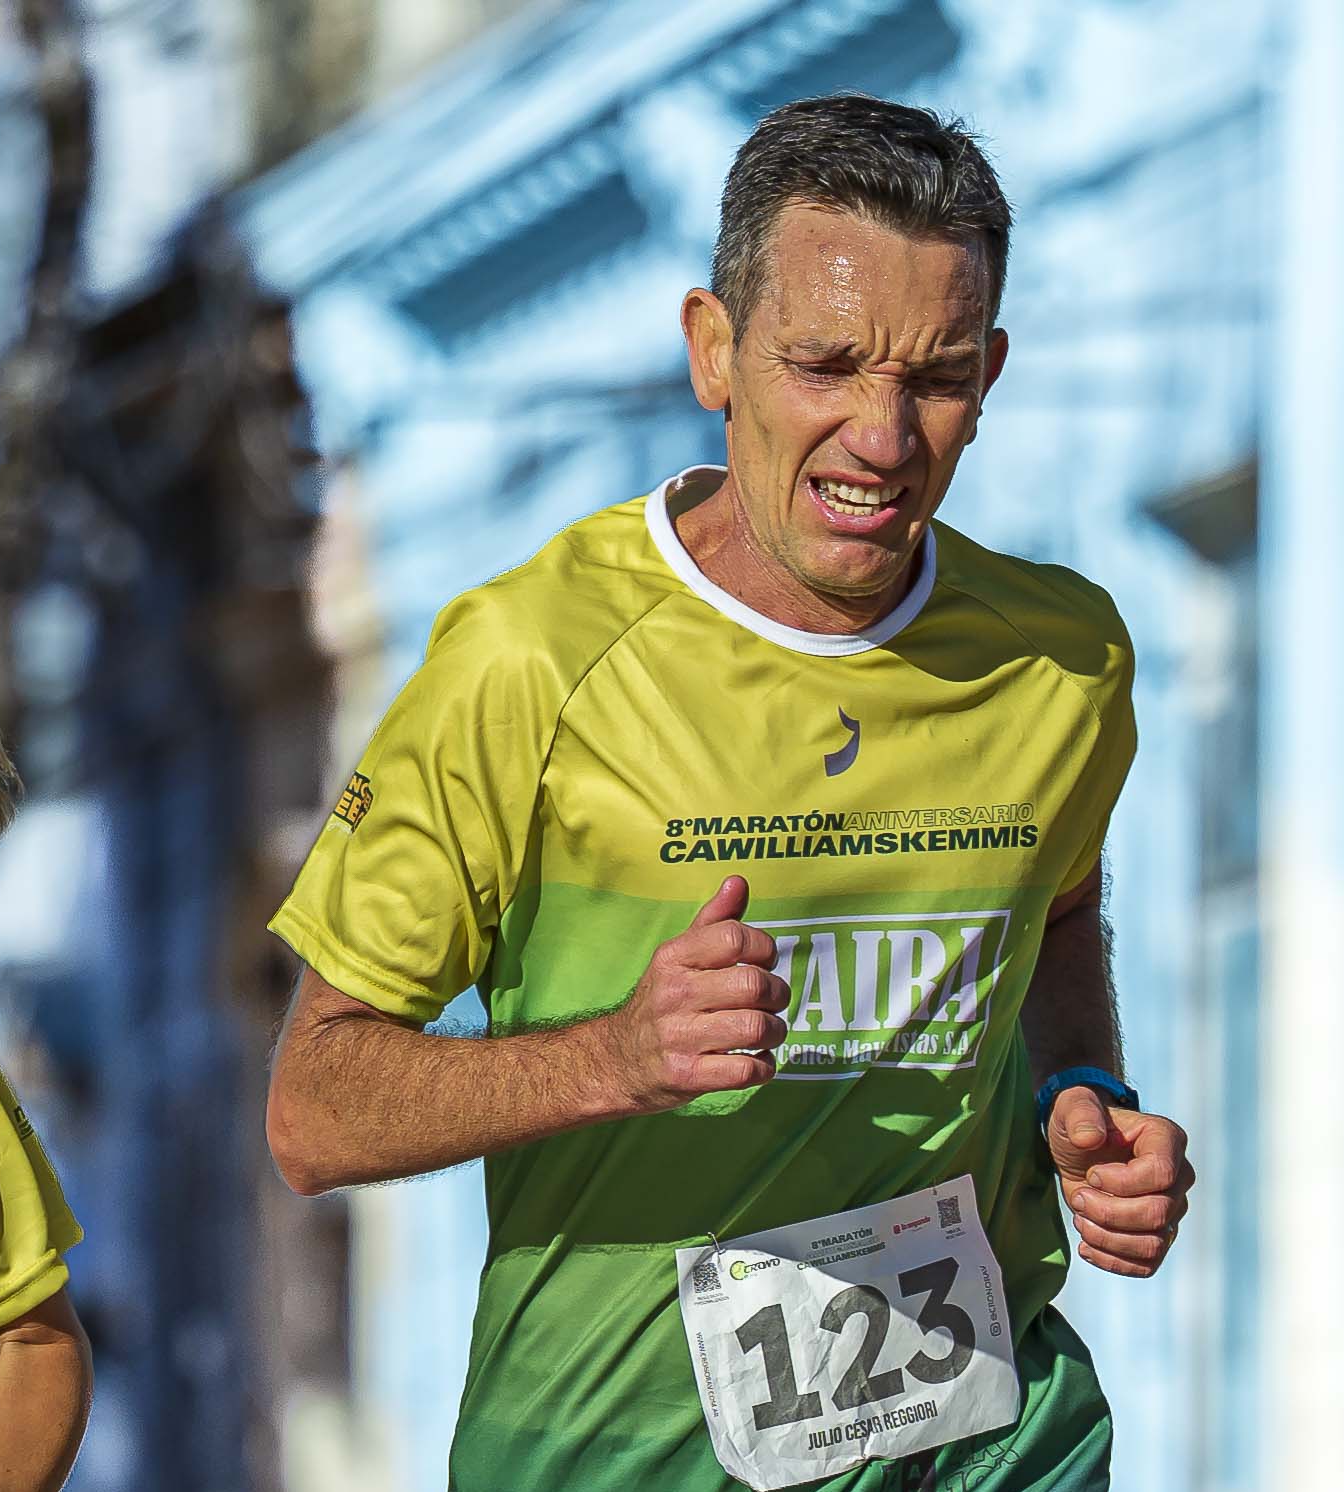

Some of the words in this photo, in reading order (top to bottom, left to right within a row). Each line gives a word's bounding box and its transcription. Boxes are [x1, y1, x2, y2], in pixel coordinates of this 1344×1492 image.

[843, 802, 1035, 831] ANIVERSARIO
[658, 824, 1039, 864] CAWILLIAMSKEMMIS
[775, 1042, 837, 1065] cenes
[735, 1256, 977, 1431] 123
[808, 1425, 843, 1450] JULIO
[882, 1400, 938, 1431] REGGIORI
